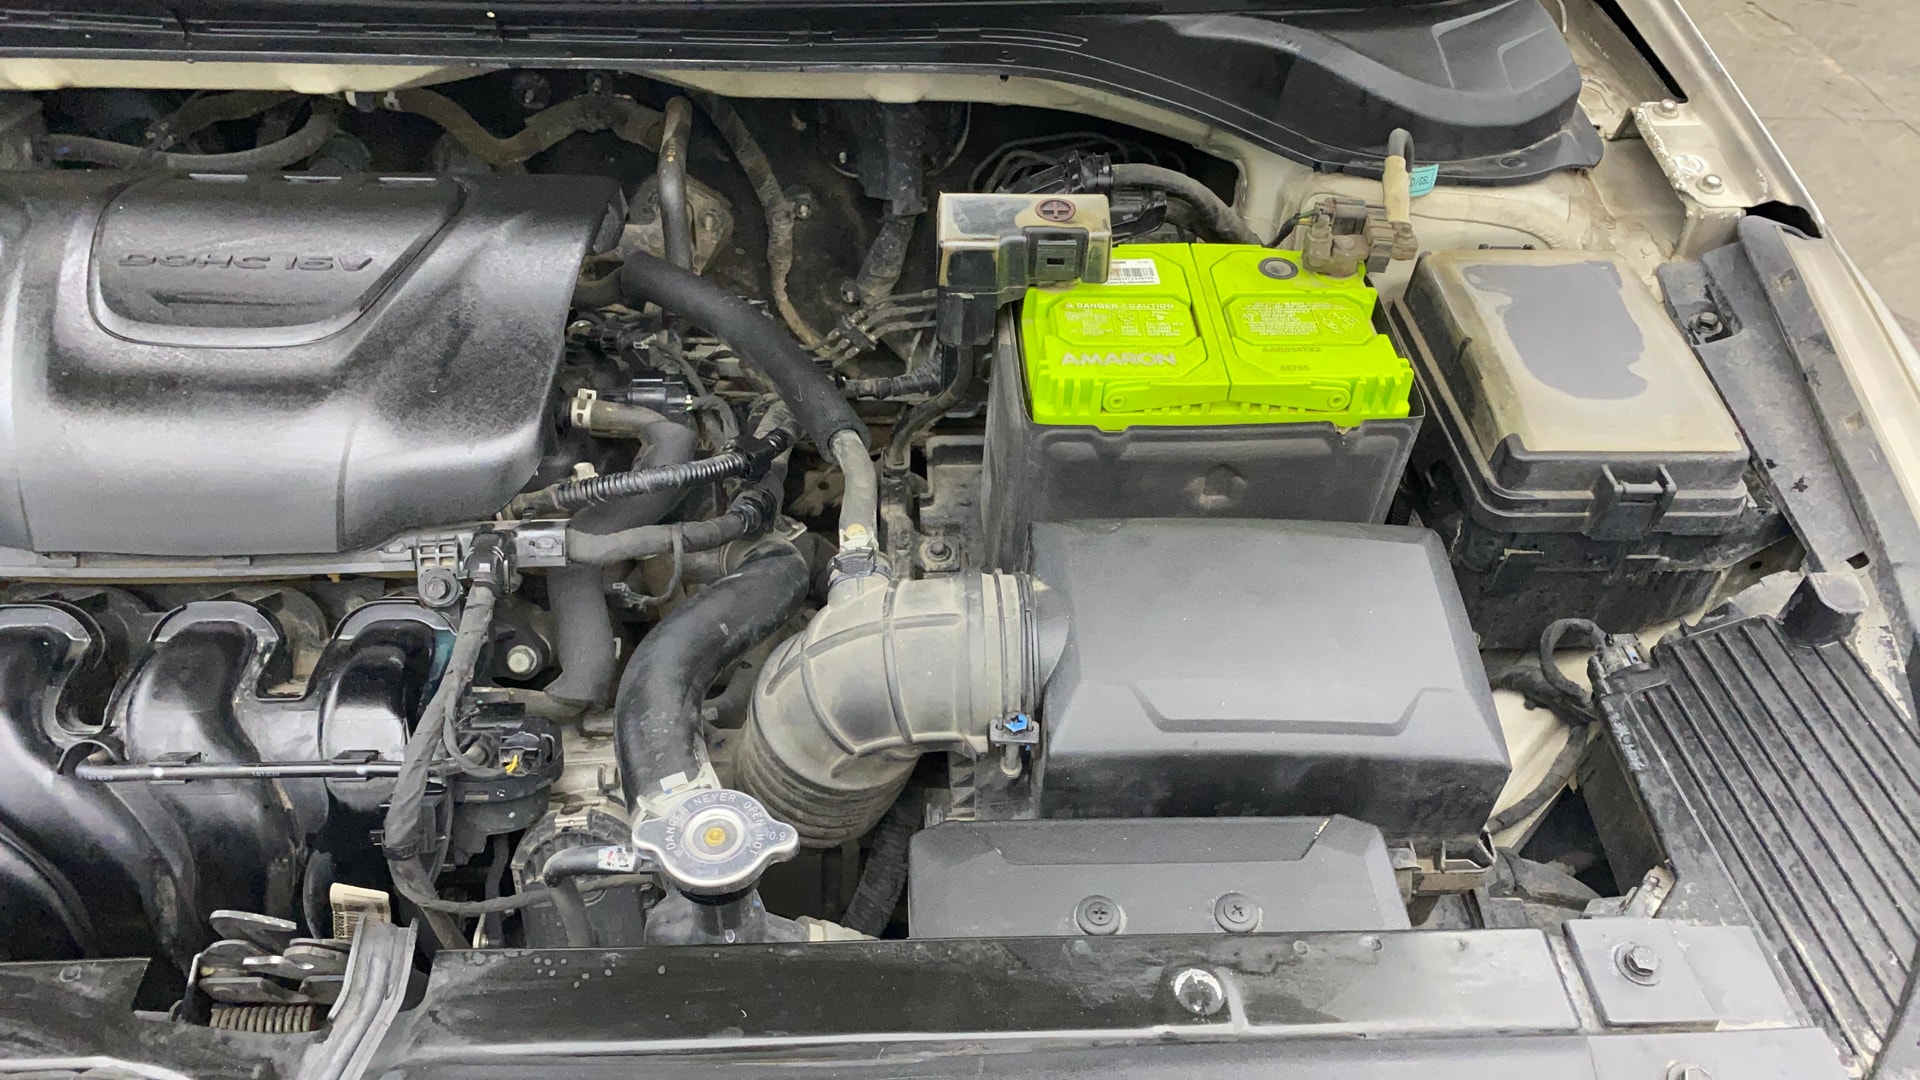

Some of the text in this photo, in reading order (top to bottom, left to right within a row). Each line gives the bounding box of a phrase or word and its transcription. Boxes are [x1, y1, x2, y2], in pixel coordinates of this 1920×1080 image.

[117, 253, 373, 272] DOHC 16V
[1075, 302, 1118, 310] DANGER
[1128, 302, 1174, 310] CAUTION
[1061, 352, 1177, 366] AMARON
[666, 792, 765, 856] DANGER NEVER OPEN HOT
[769, 831, 786, 841] 0.9
